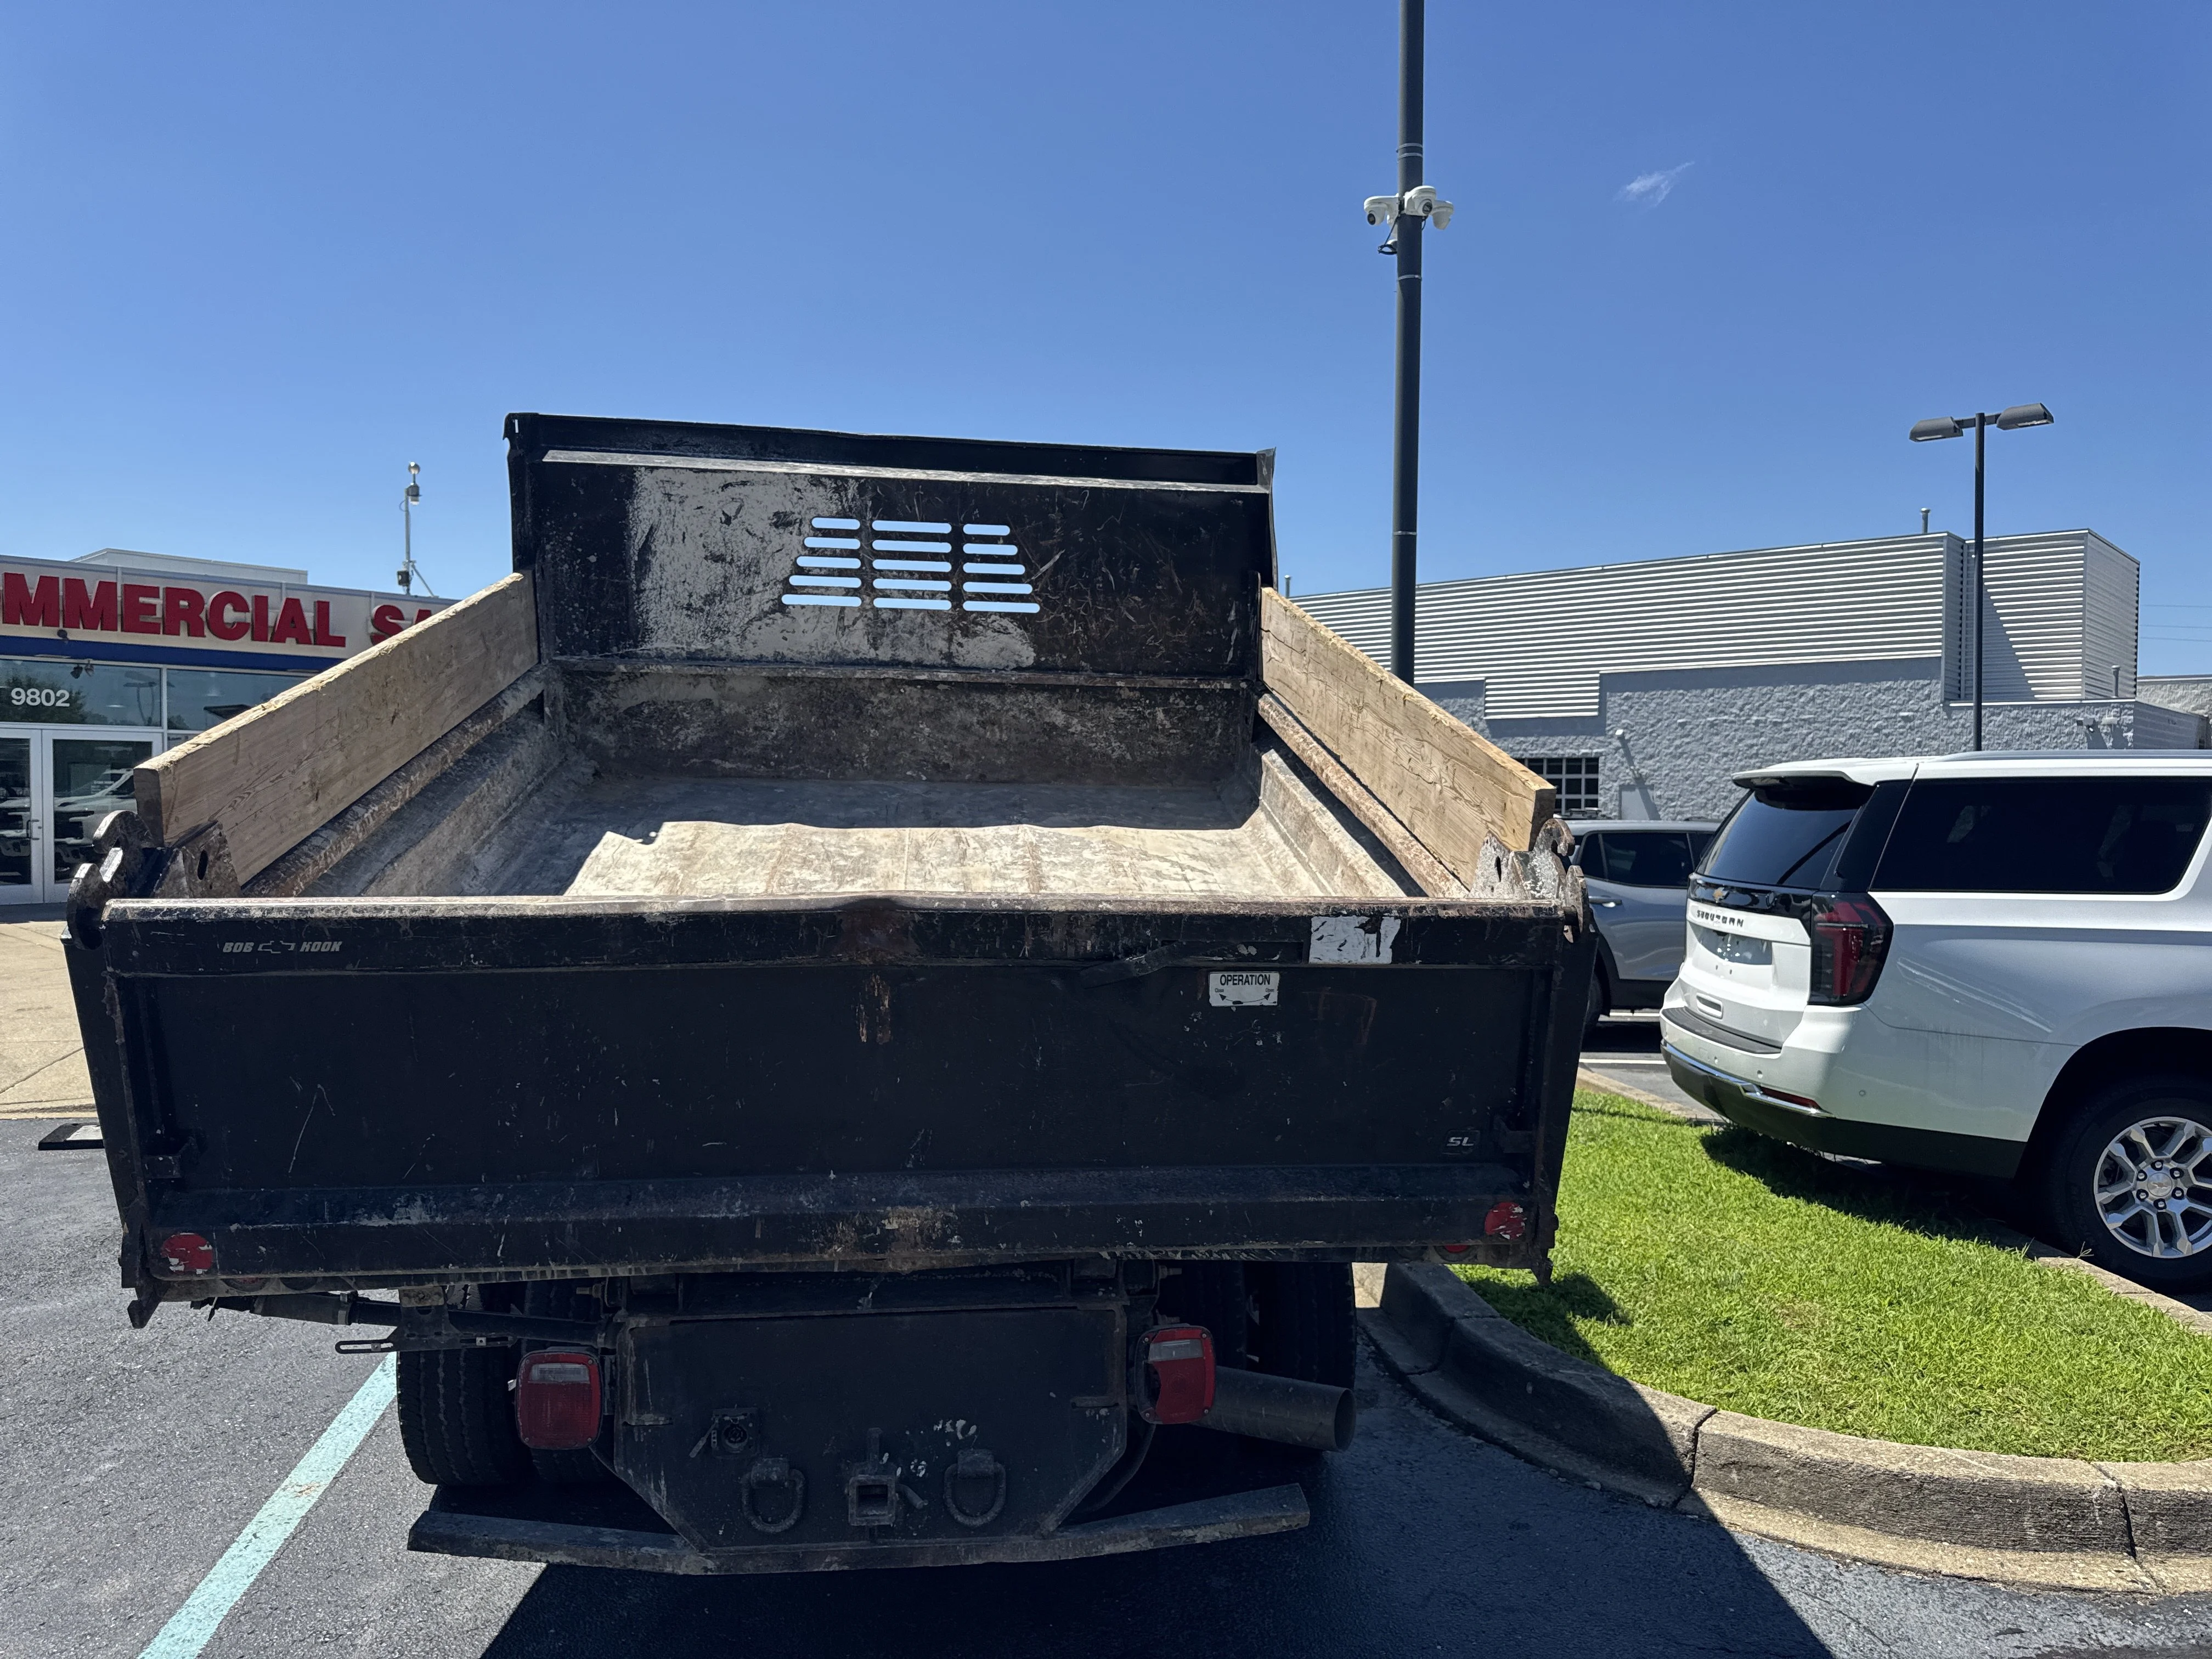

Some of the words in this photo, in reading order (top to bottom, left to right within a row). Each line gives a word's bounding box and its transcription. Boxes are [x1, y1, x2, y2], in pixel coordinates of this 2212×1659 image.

[2, 572, 346, 647] MMERCIAL
[370, 605, 432, 646] S
[11, 687, 70, 707] 9802
[222, 942, 255, 953] BOB
[1220, 974, 1271, 986] OPERATION
[1446, 1137, 1474, 1147] SL
